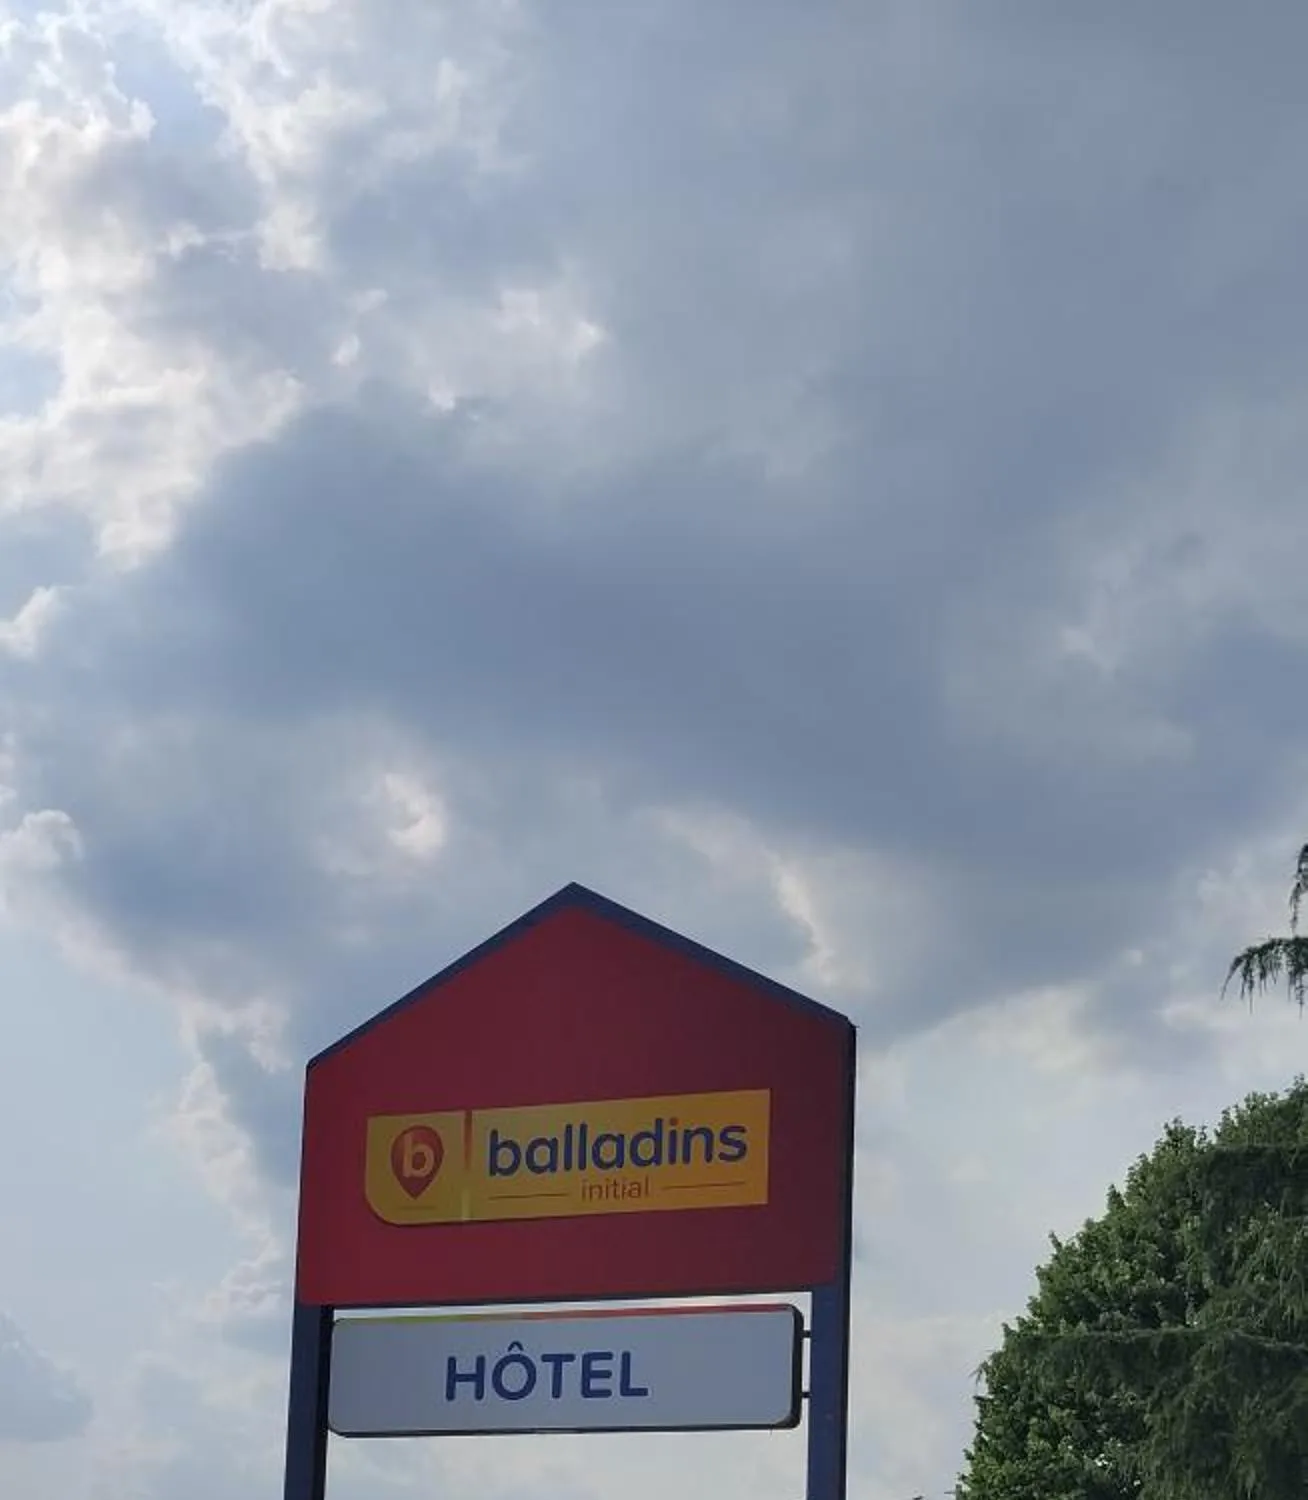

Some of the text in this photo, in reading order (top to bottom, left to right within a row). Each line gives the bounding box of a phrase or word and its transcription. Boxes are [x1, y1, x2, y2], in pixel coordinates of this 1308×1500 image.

[402, 1132, 435, 1178] b
[488, 1118, 748, 1177] balladins
[581, 1176, 650, 1202] initial
[445, 1341, 648, 1401] HÔTEL
